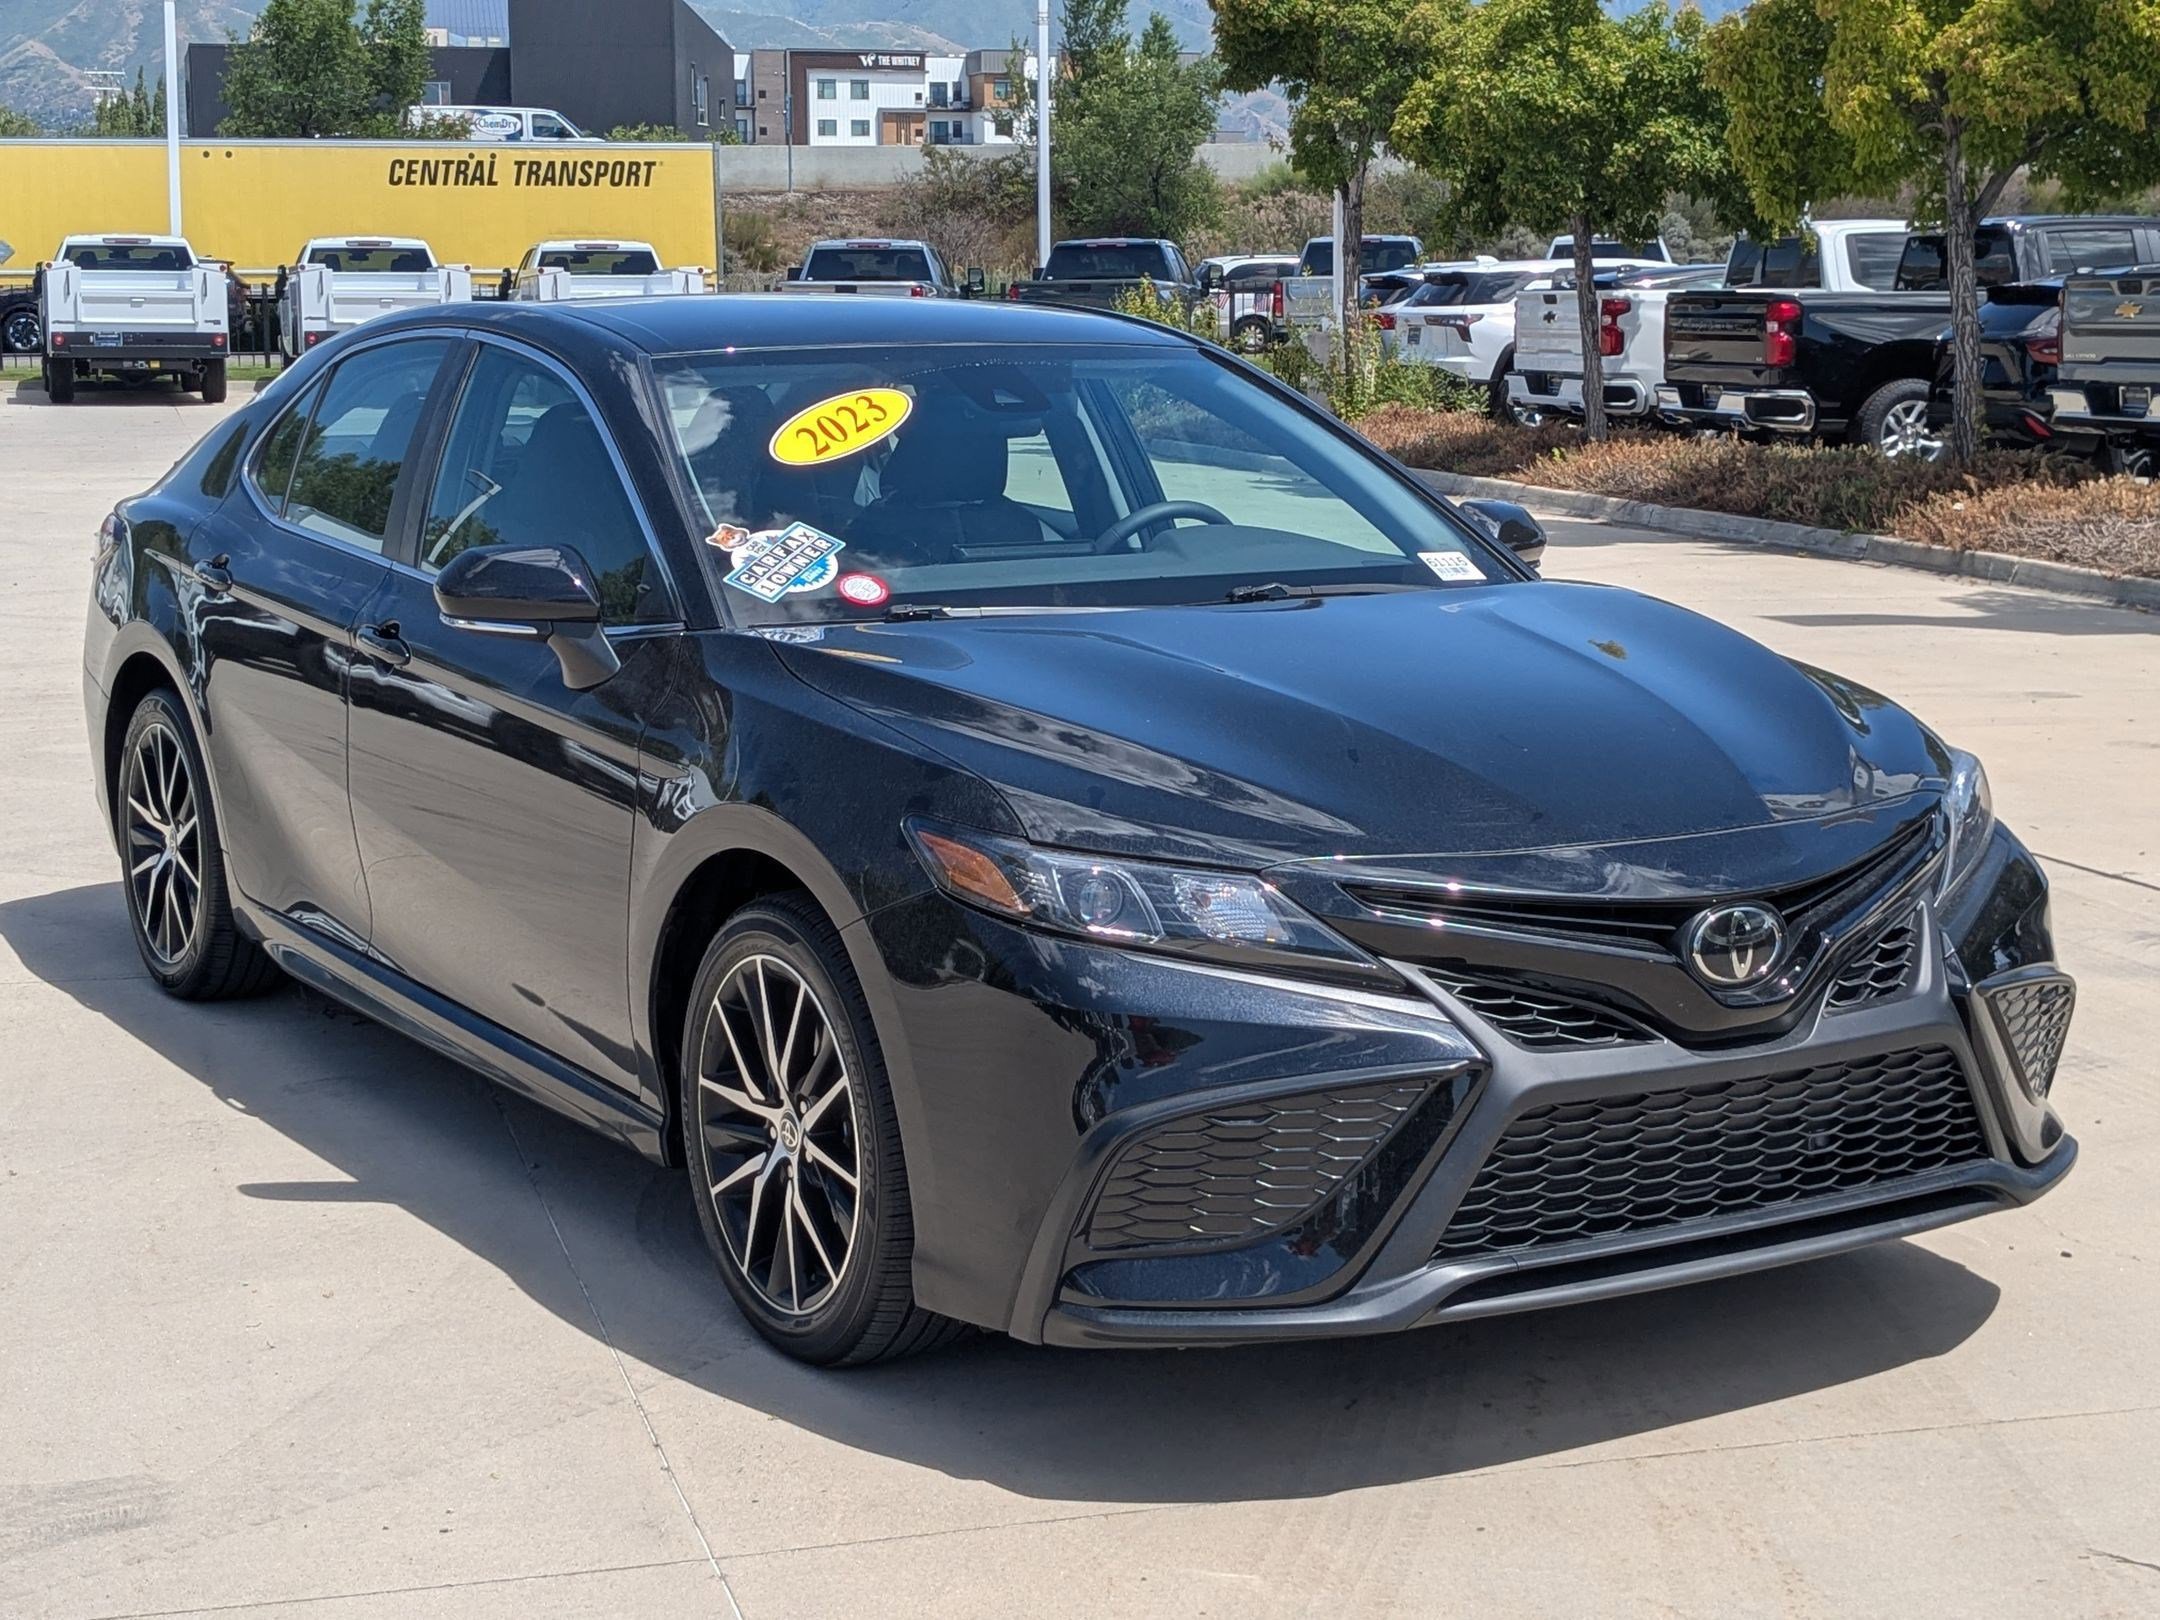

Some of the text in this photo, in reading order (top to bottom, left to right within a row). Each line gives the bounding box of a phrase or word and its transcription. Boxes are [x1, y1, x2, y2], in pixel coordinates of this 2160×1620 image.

[878, 55, 891, 66] THE
[388, 158, 657, 188] CENTRAL TRANSPORT
[795, 395, 887, 456] 2023
[740, 531, 815, 585] CARFAX
[760, 584, 776, 593] 1
[770, 537, 832, 585] OWNER
[1426, 556, 1468, 568] 61115
